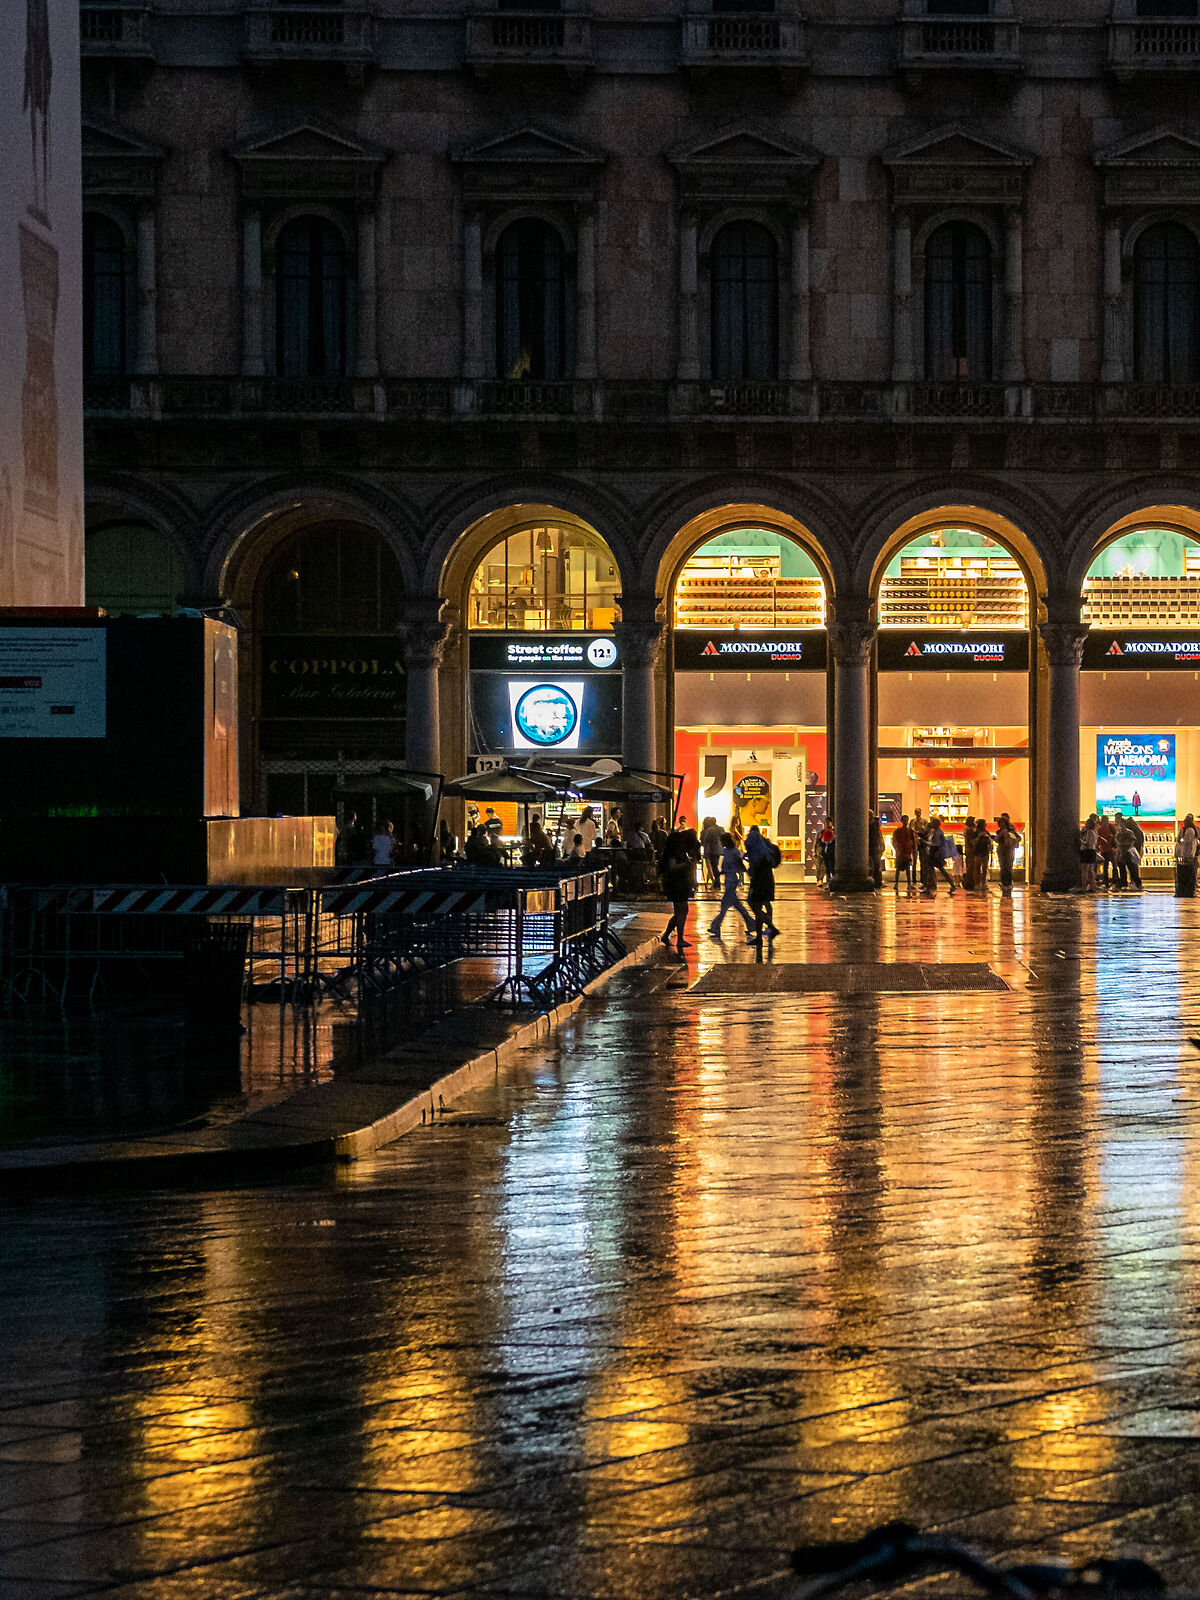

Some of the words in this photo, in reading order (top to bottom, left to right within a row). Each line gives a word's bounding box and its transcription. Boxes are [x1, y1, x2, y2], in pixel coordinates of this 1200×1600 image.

[508, 644, 545, 654] Street
[545, 644, 584, 654] coffee
[720, 643, 802, 653] MONDADORI
[922, 643, 1004, 654] MONDADORI
[269, 659, 407, 675] COPPOLA
[1104, 745, 1154, 755] MARSONS
[1105, 755, 1118, 766] LA
[1119, 755, 1169, 766] MEMORIA
[1107, 766, 1126, 777] DEI
